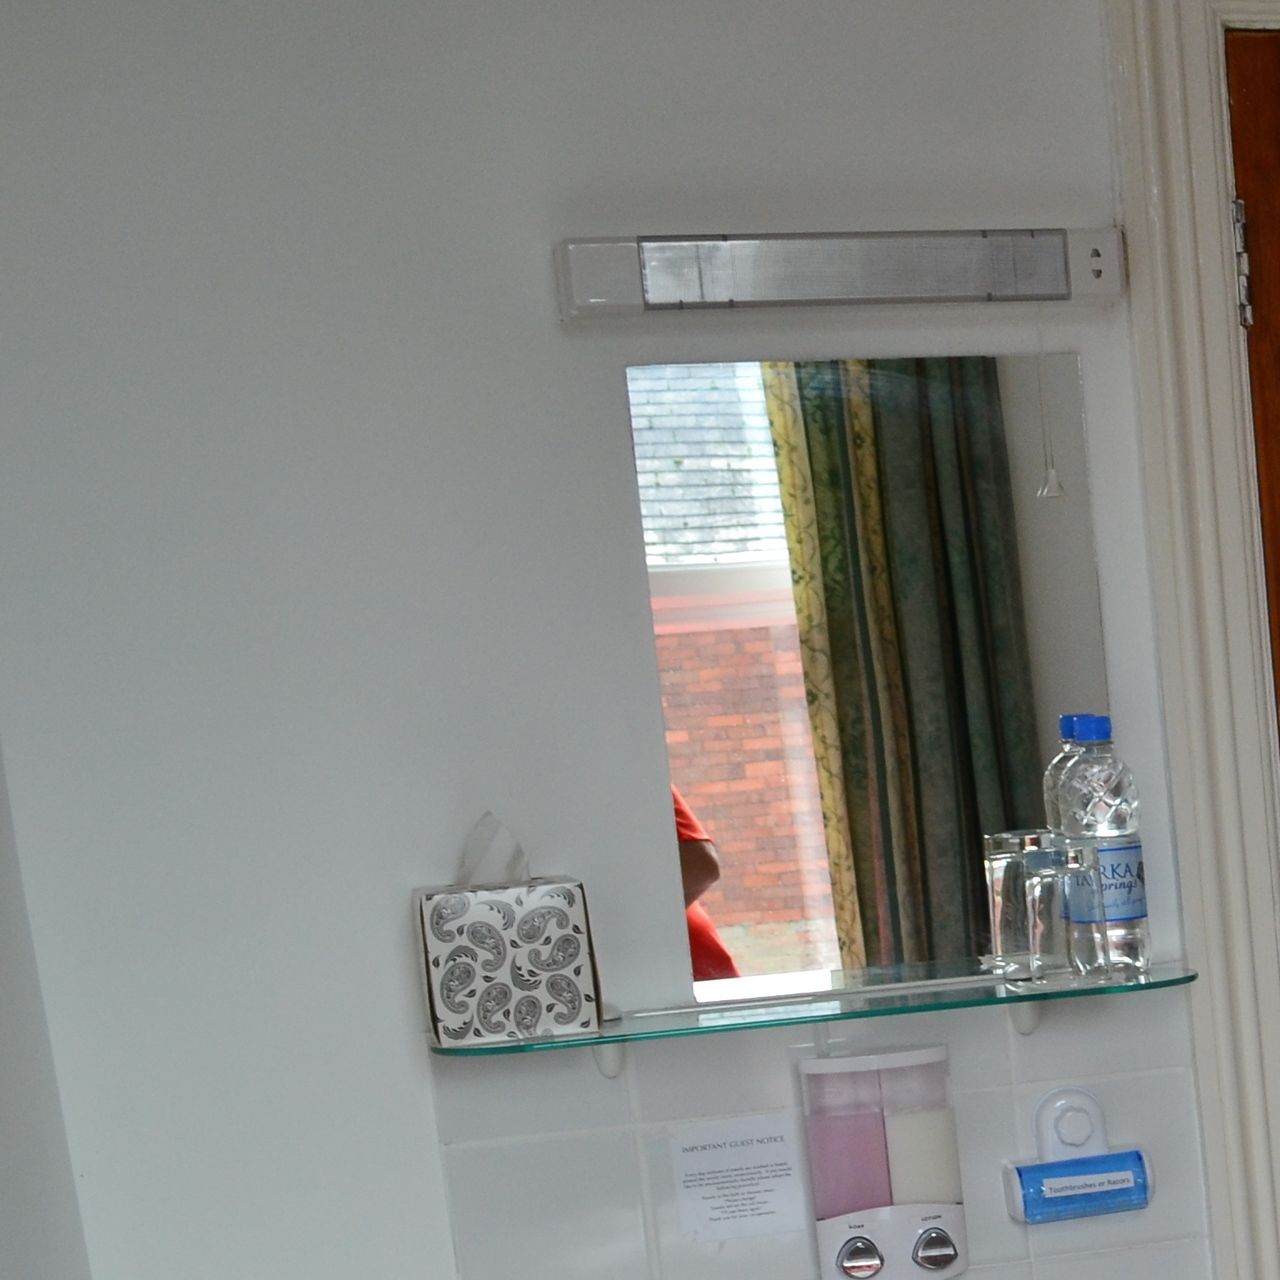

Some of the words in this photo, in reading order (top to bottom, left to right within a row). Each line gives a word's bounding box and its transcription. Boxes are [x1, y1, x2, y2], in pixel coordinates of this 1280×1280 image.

[682, 1142, 728, 1153] IMPORTANT
[729, 1139, 754, 1148] GUEST
[756, 1135, 784, 1144] NOTICE
[1049, 1182, 1097, 1194] Toothbrushes
[1107, 1178, 1130, 1187] Razors
